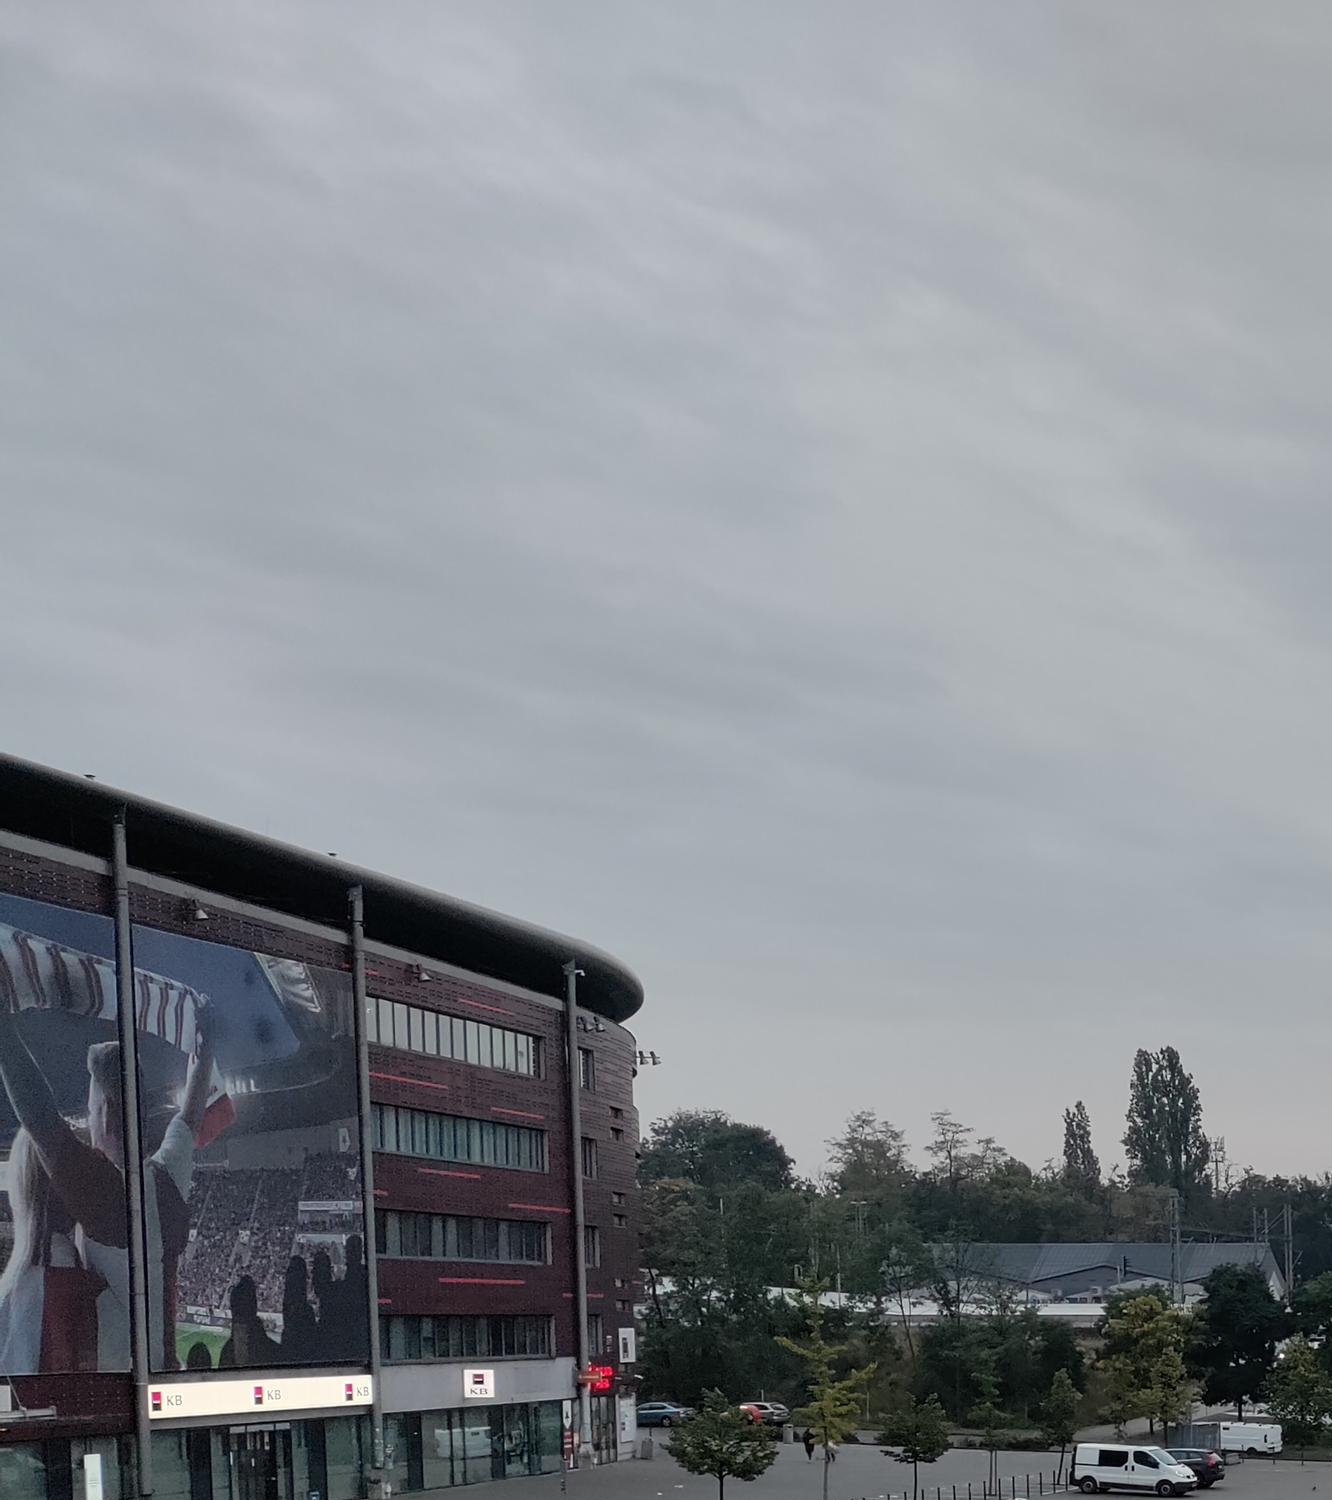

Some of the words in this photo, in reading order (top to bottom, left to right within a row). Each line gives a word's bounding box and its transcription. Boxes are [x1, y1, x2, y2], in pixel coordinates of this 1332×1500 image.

[266, 1390, 281, 1400] KB
[357, 1386, 369, 1397] KB
[166, 1395, 182, 1406] KB
